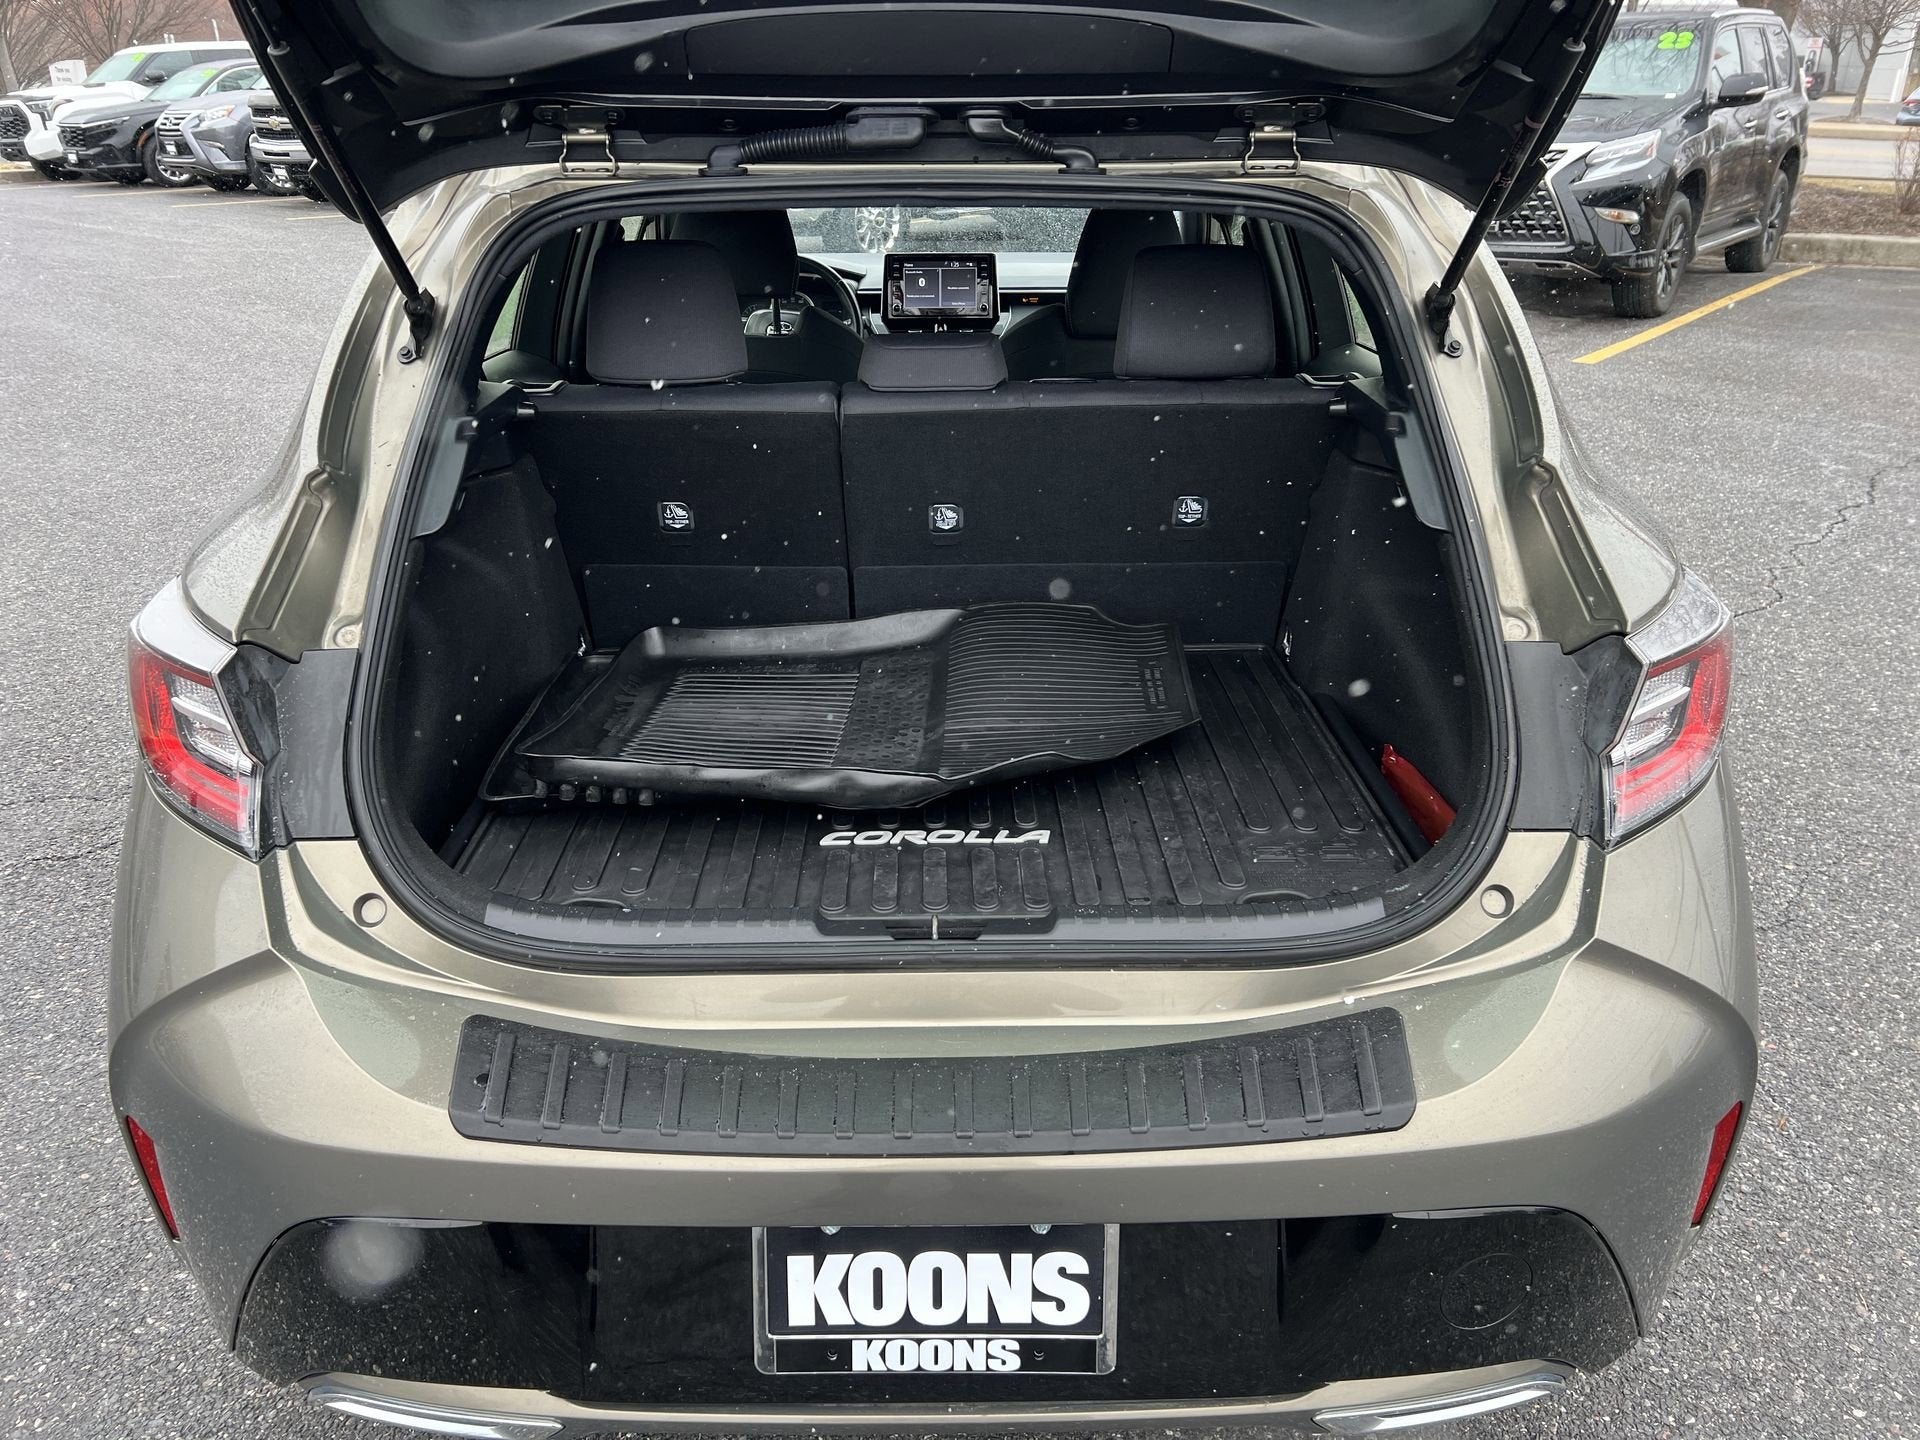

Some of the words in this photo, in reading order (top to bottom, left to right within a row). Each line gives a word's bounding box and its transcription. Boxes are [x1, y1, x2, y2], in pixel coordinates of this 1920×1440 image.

[1657, 31, 1694, 49] 23
[819, 829, 1051, 846] COROLLA
[786, 1250, 1091, 1327] KOONS
[851, 1339, 1022, 1372] KOONS
